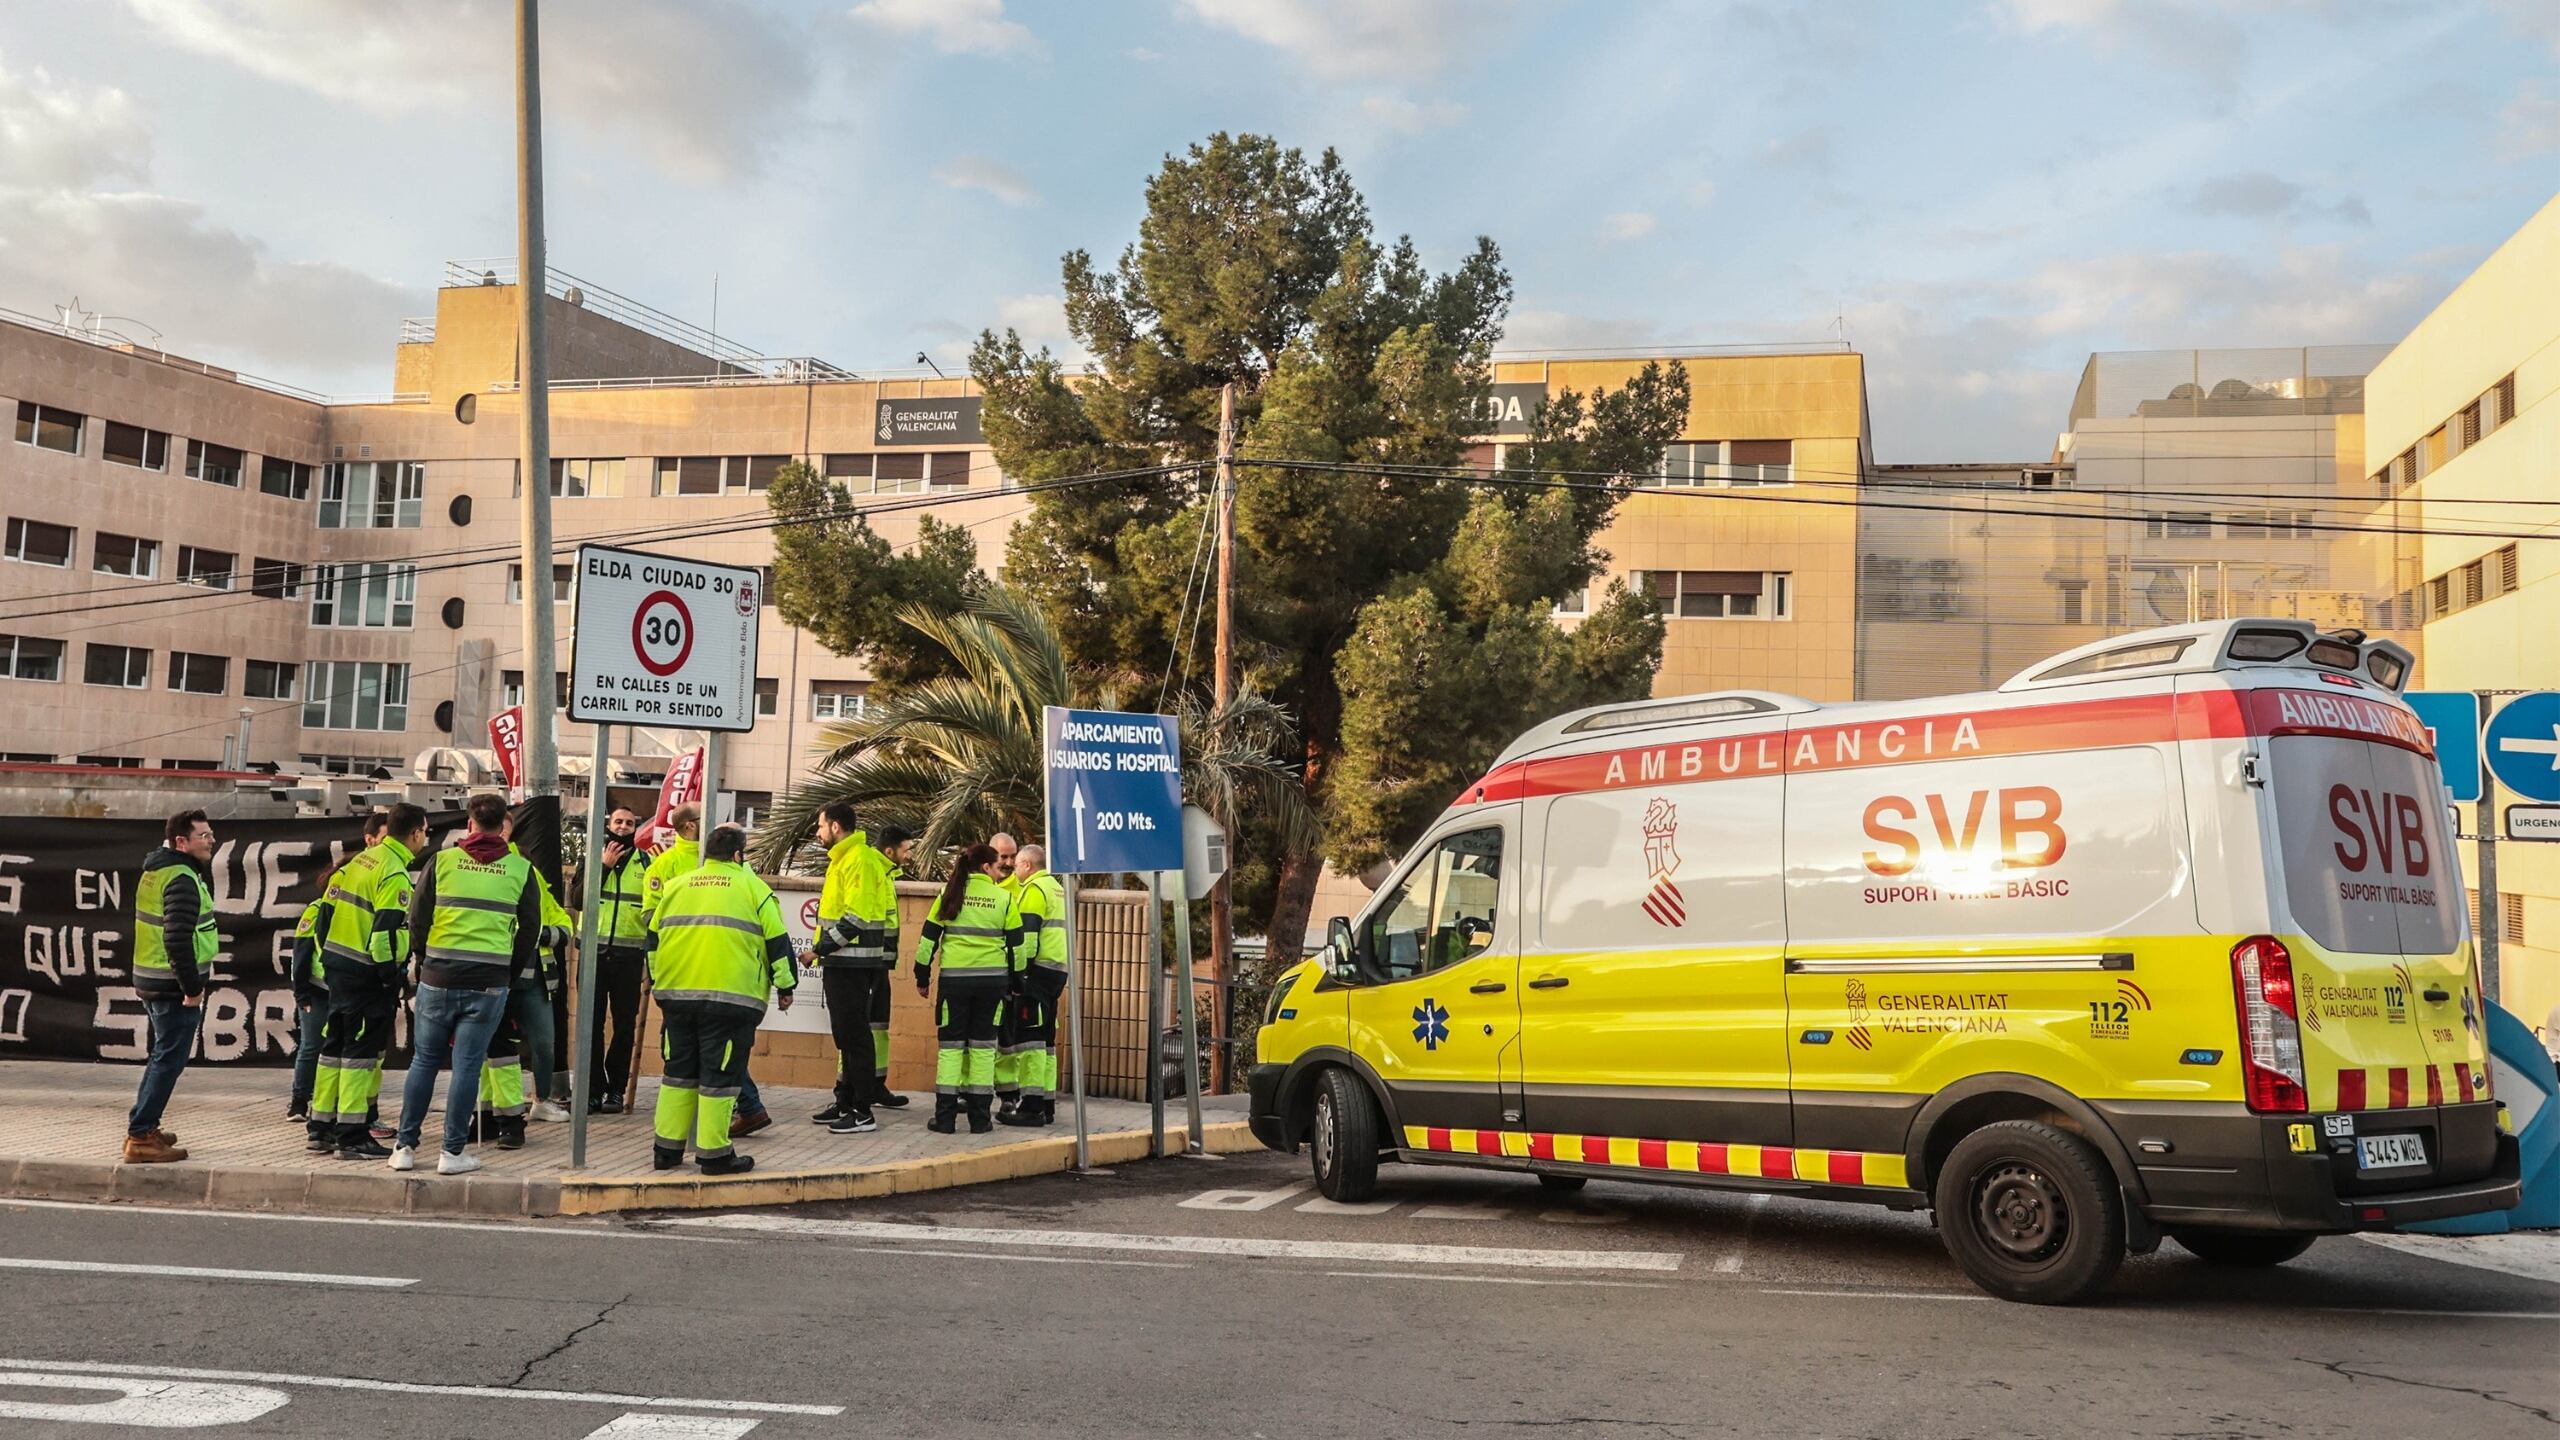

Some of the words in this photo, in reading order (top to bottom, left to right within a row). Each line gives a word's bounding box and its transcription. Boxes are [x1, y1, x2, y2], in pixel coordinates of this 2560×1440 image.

[895, 410, 959, 422] GENERALITAT
[896, 421, 957, 432] VALENCIANA
[588, 558, 632, 581] ELDA
[642, 566, 706, 590] CIUDAD
[713, 576, 734, 594] 30
[645, 616, 681, 646] 30
[596, 675, 614, 689] EN
[621, 677, 670, 694] CALLES
[676, 682, 693, 696] DE
[699, 685, 718, 698] UN
[580, 696, 629, 712] CARRIL
[635, 700, 661, 714] POR
[668, 702, 723, 719] SENTIDO
[2278, 692, 2426, 748] AMBULANCIA
[1061, 721, 1164, 745] APARCAMIENTO
[1050, 749, 1112, 771] USUARIOS
[1116, 752, 1179, 773] HOSPITAL
[1603, 717, 1981, 785] AMBULANCIA
[1096, 811, 1124, 831] 200
[1128, 812, 1156, 831] Mts.
[1861, 785, 2068, 877] SVB
[2328, 783, 2430, 877] SVB
[457, 864, 507, 876] SANITARI
[75, 868, 121, 911] EN
[688, 880, 731, 888] SANITARI
[2007, 877, 2070, 898] BÀSIC
[2340, 882, 2382, 902] SUPORT
[2384, 886, 2410, 904] VITAL
[963, 901, 996, 909] ANITARI
[24, 924, 127, 986] QUE
[1877, 993, 2009, 1011] GENERALITAT
[2319, 986, 2377, 1001] GENERALITAT
[2384, 986, 2404, 1007] 112
[2089, 1001, 2129, 1023] 112
[2322, 1004, 2379, 1018] VALENCIANA
[1880, 1016, 2008, 1033] VALENCIANA
[2327, 1118, 2351, 1135] SP
[2366, 1139, 2399, 1164] 5445
[2400, 1137, 2423, 1162] MGL
